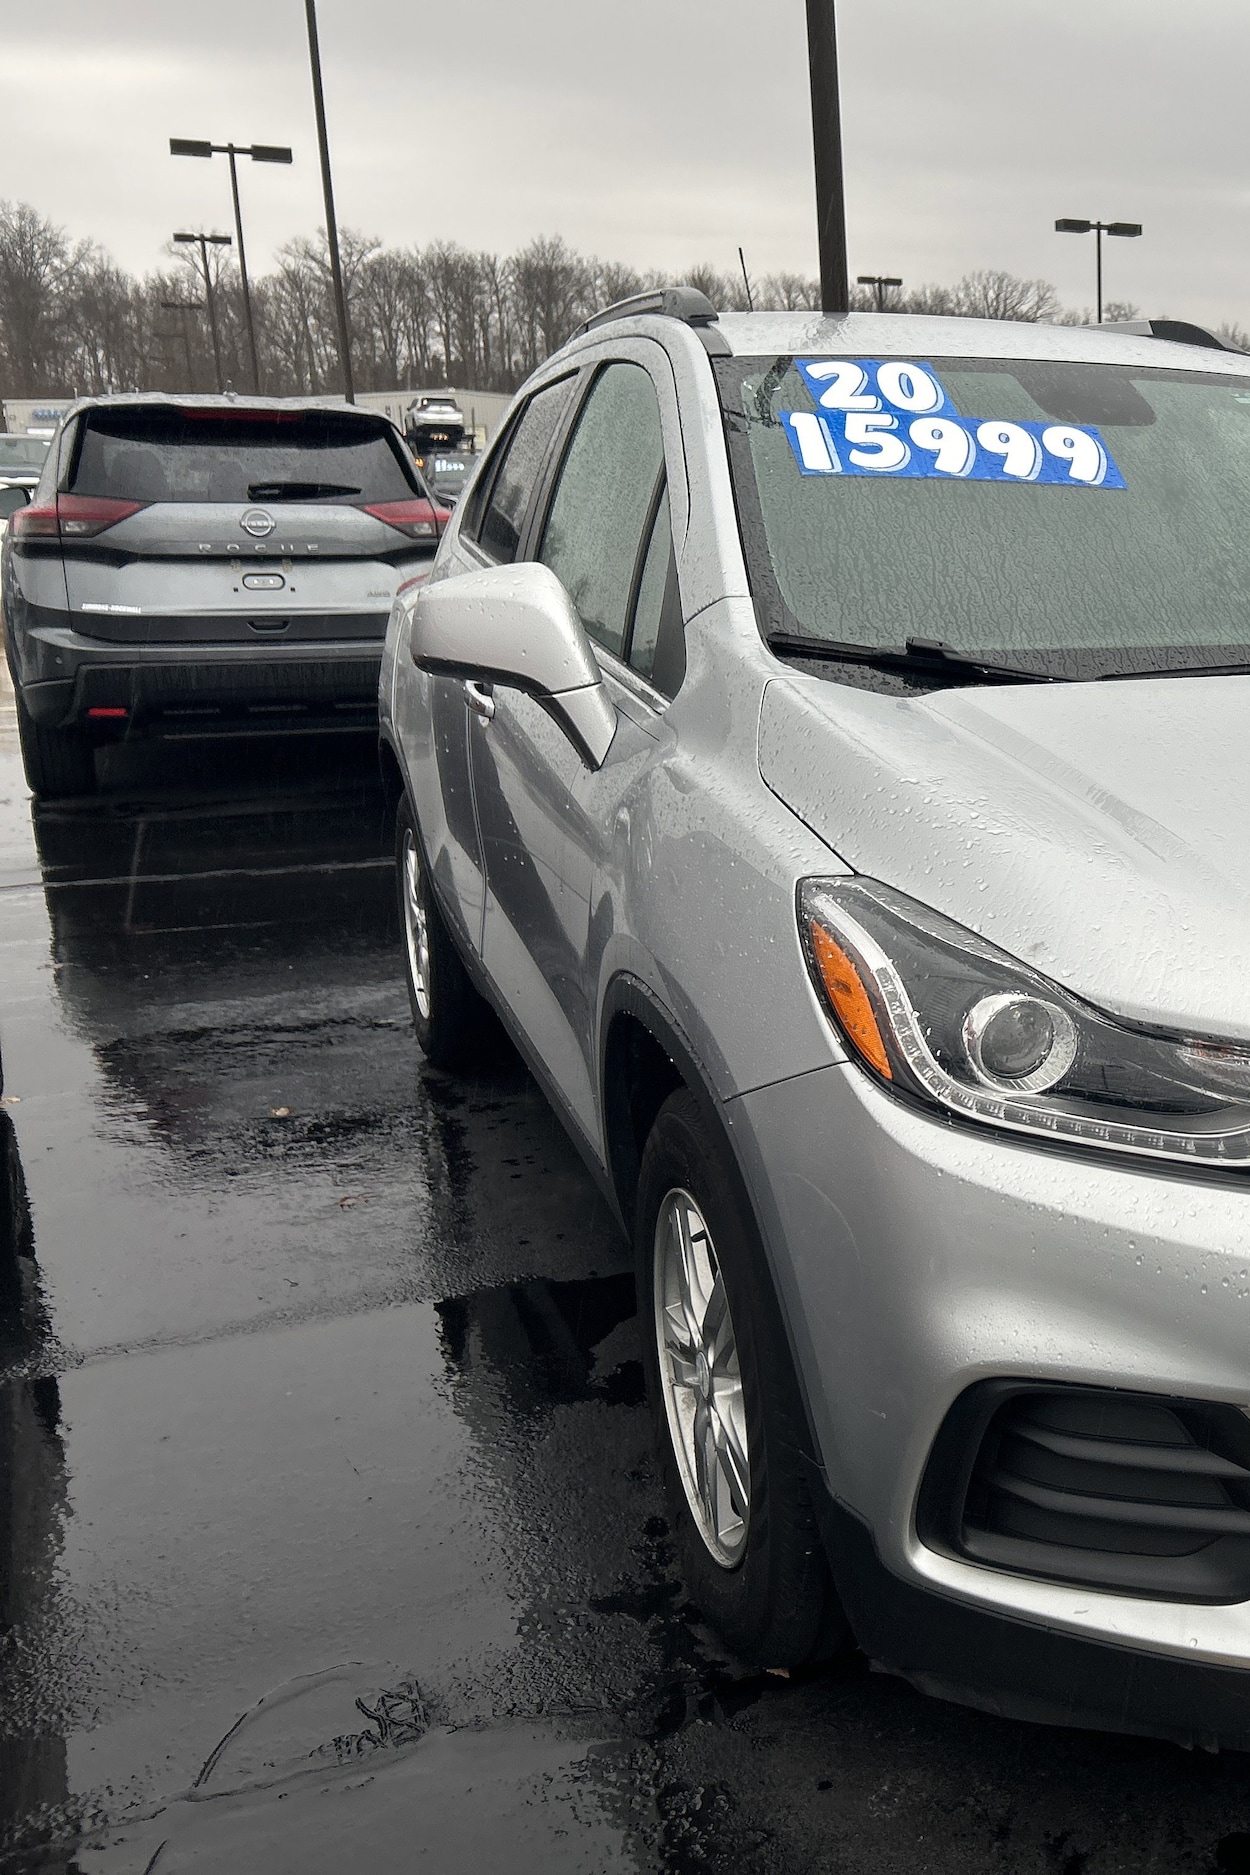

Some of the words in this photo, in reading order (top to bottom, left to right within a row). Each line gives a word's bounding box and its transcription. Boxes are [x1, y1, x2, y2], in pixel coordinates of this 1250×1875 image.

[805, 361, 945, 413] 20
[789, 412, 1107, 485] 15999
[199, 543, 319, 553] ROGUE
